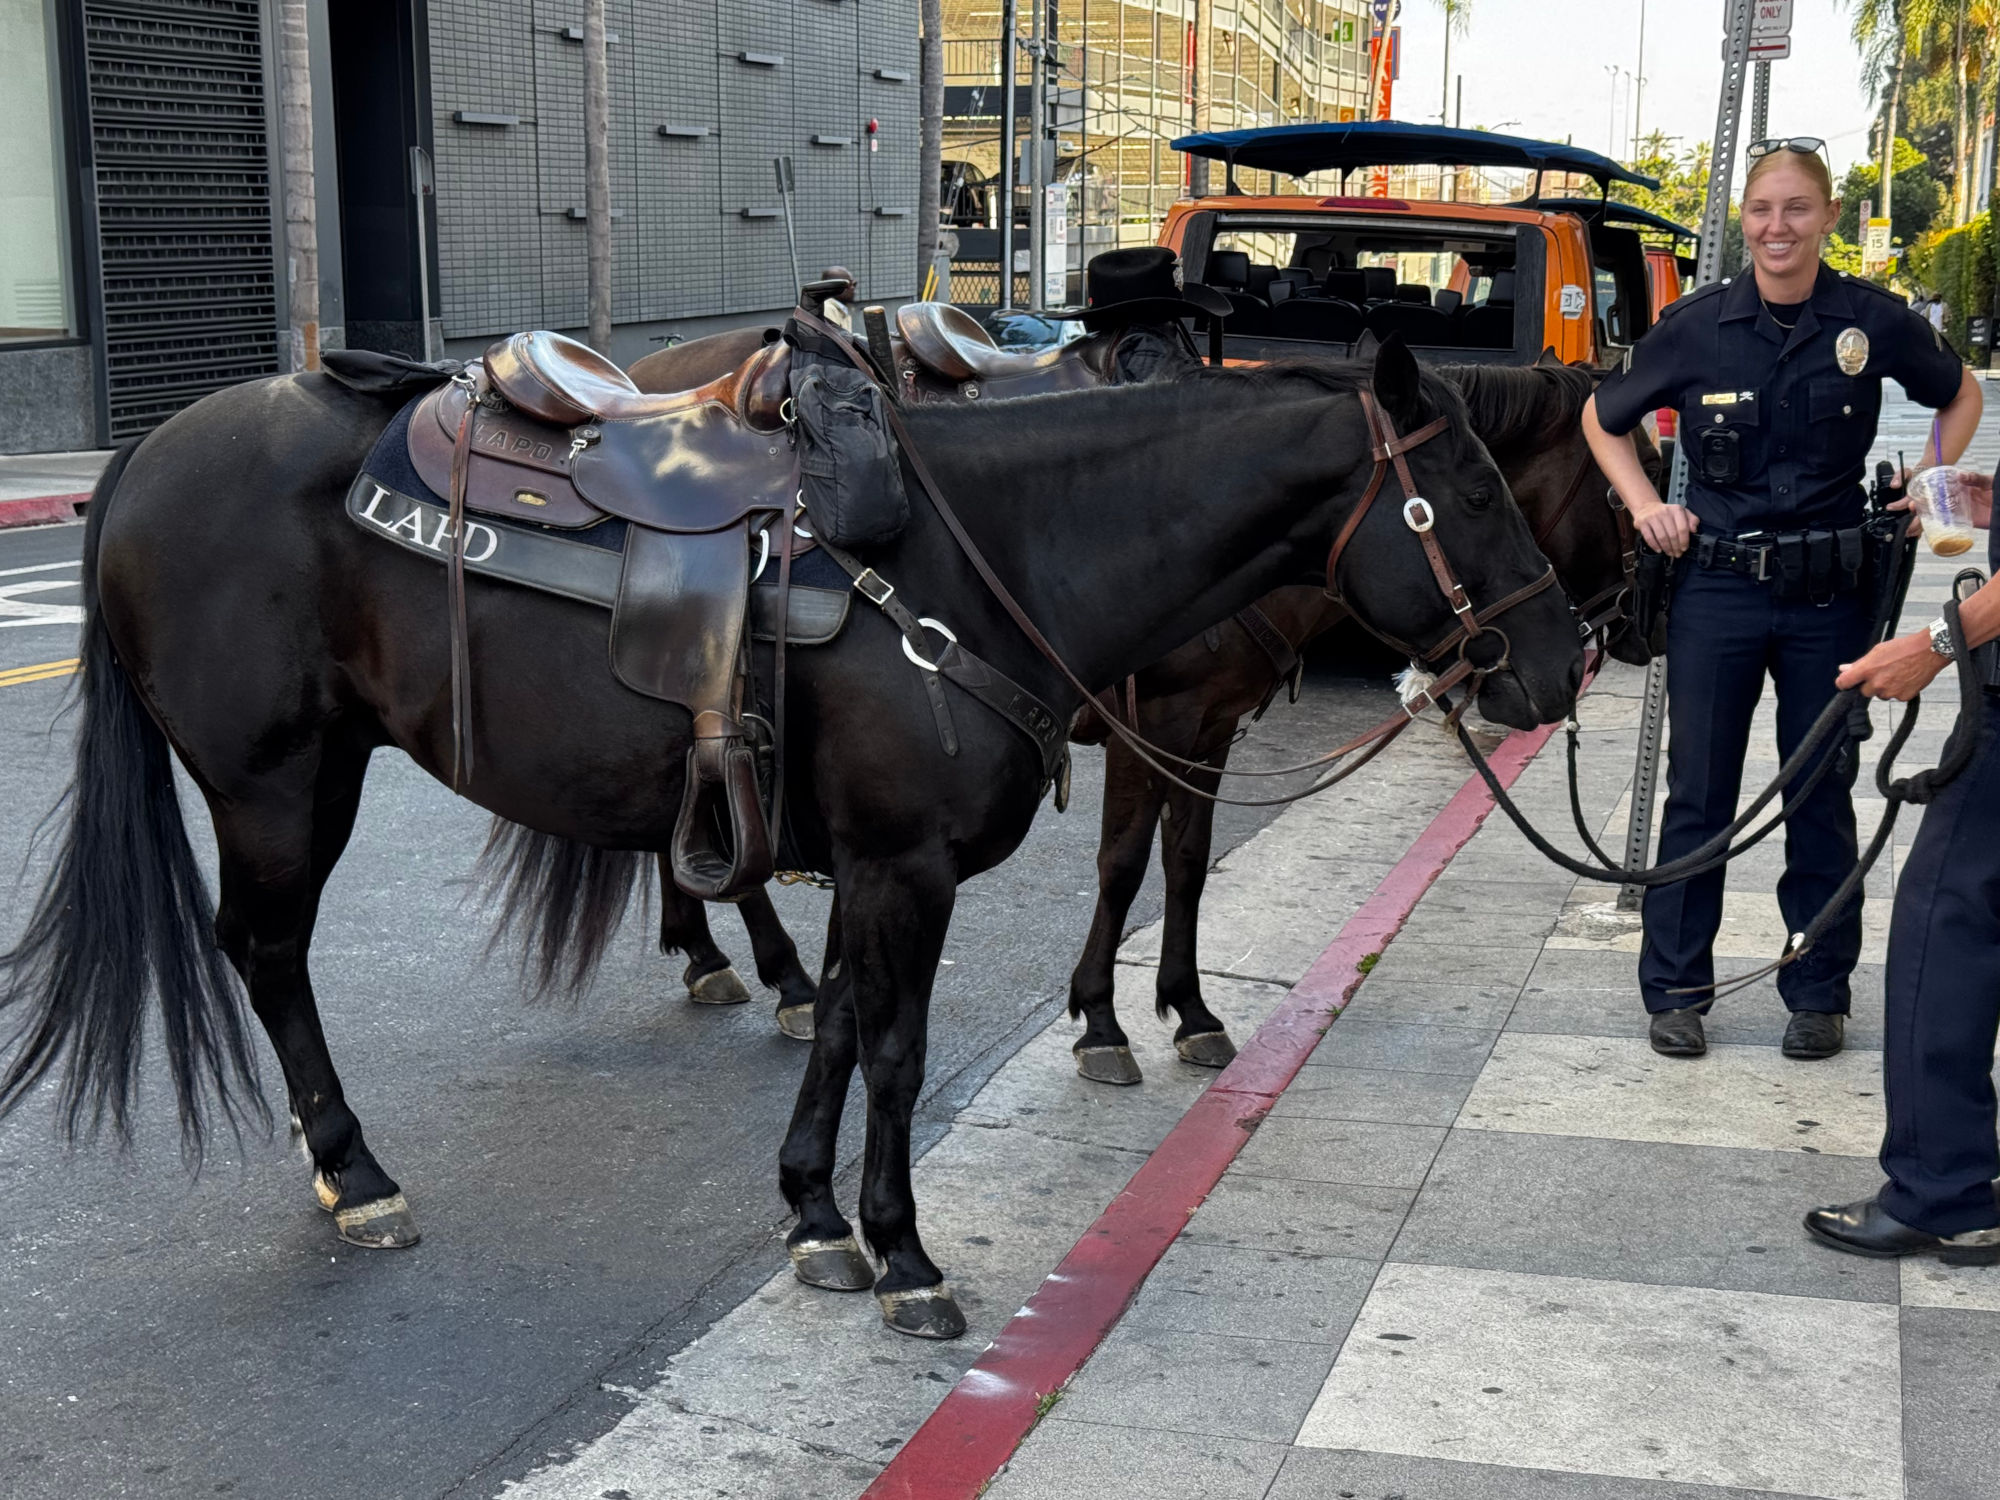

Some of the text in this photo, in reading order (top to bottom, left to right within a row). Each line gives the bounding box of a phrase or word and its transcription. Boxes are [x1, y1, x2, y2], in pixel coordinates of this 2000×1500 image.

[1760, 6, 1782, 19] ONLY
[1872, 238, 1884, 249] 15
[472, 423, 553, 462] LAPD
